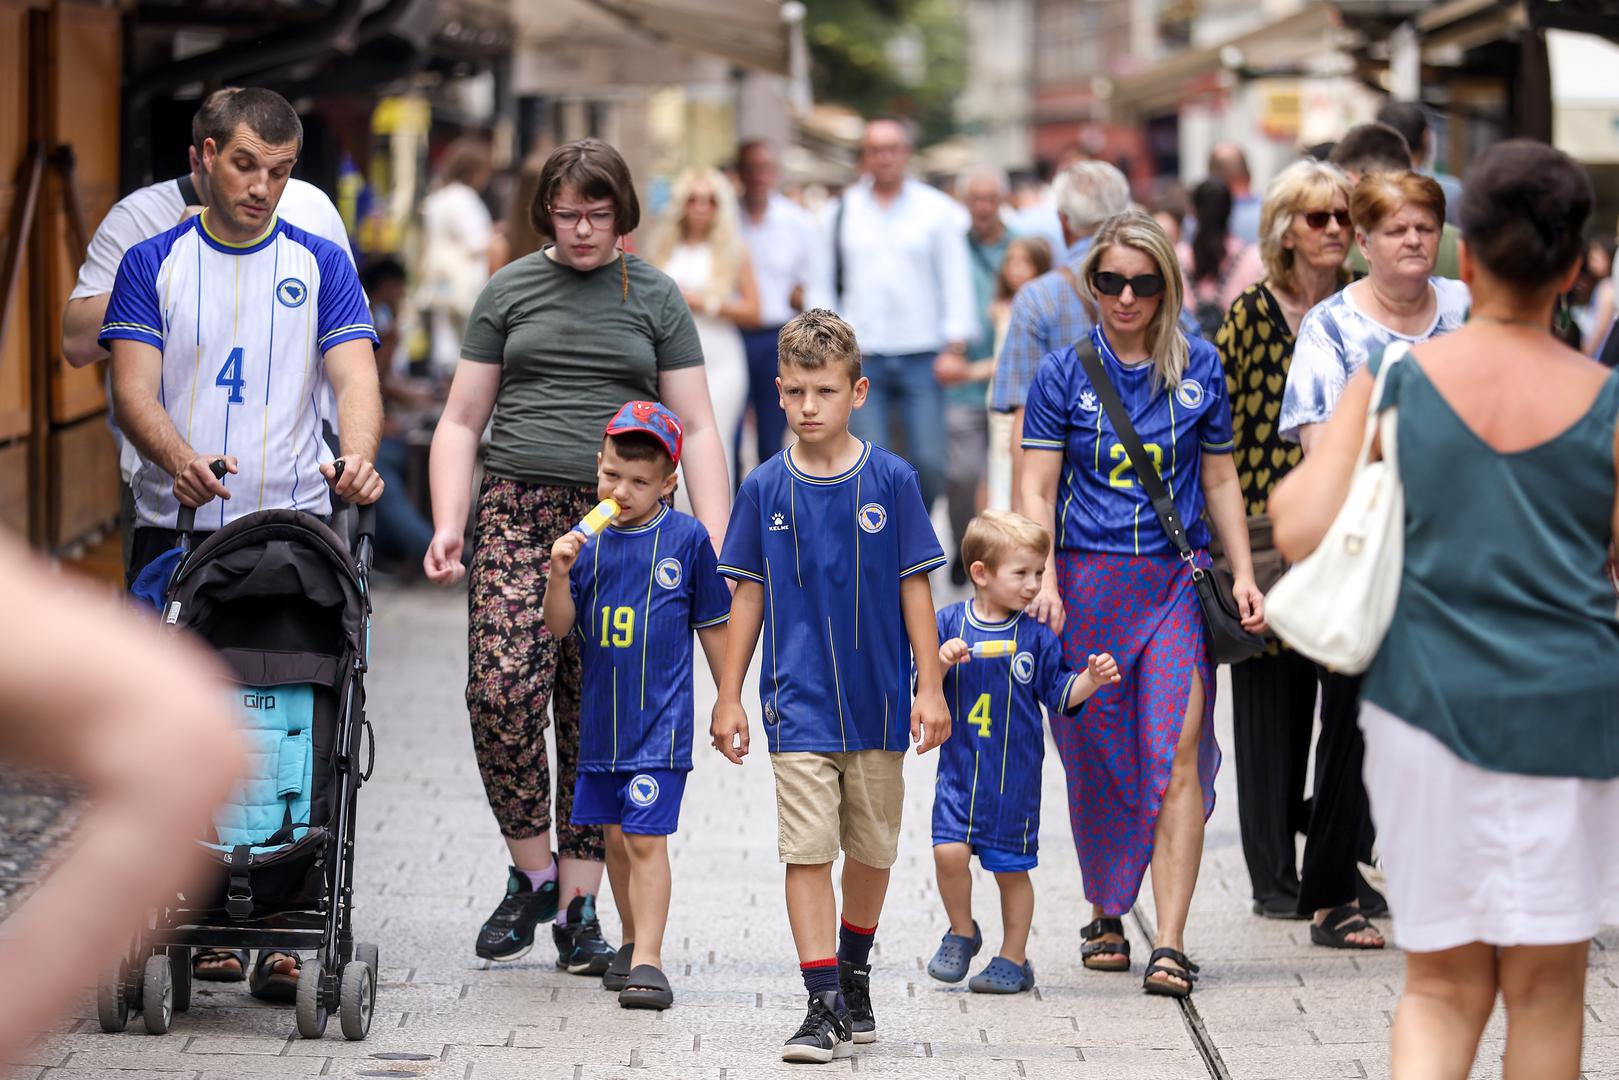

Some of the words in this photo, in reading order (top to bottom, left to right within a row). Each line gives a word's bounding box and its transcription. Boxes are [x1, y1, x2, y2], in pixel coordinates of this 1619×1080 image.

[215, 347, 246, 405] 4
[600, 605, 635, 648] 19
[967, 692, 992, 738] 4
